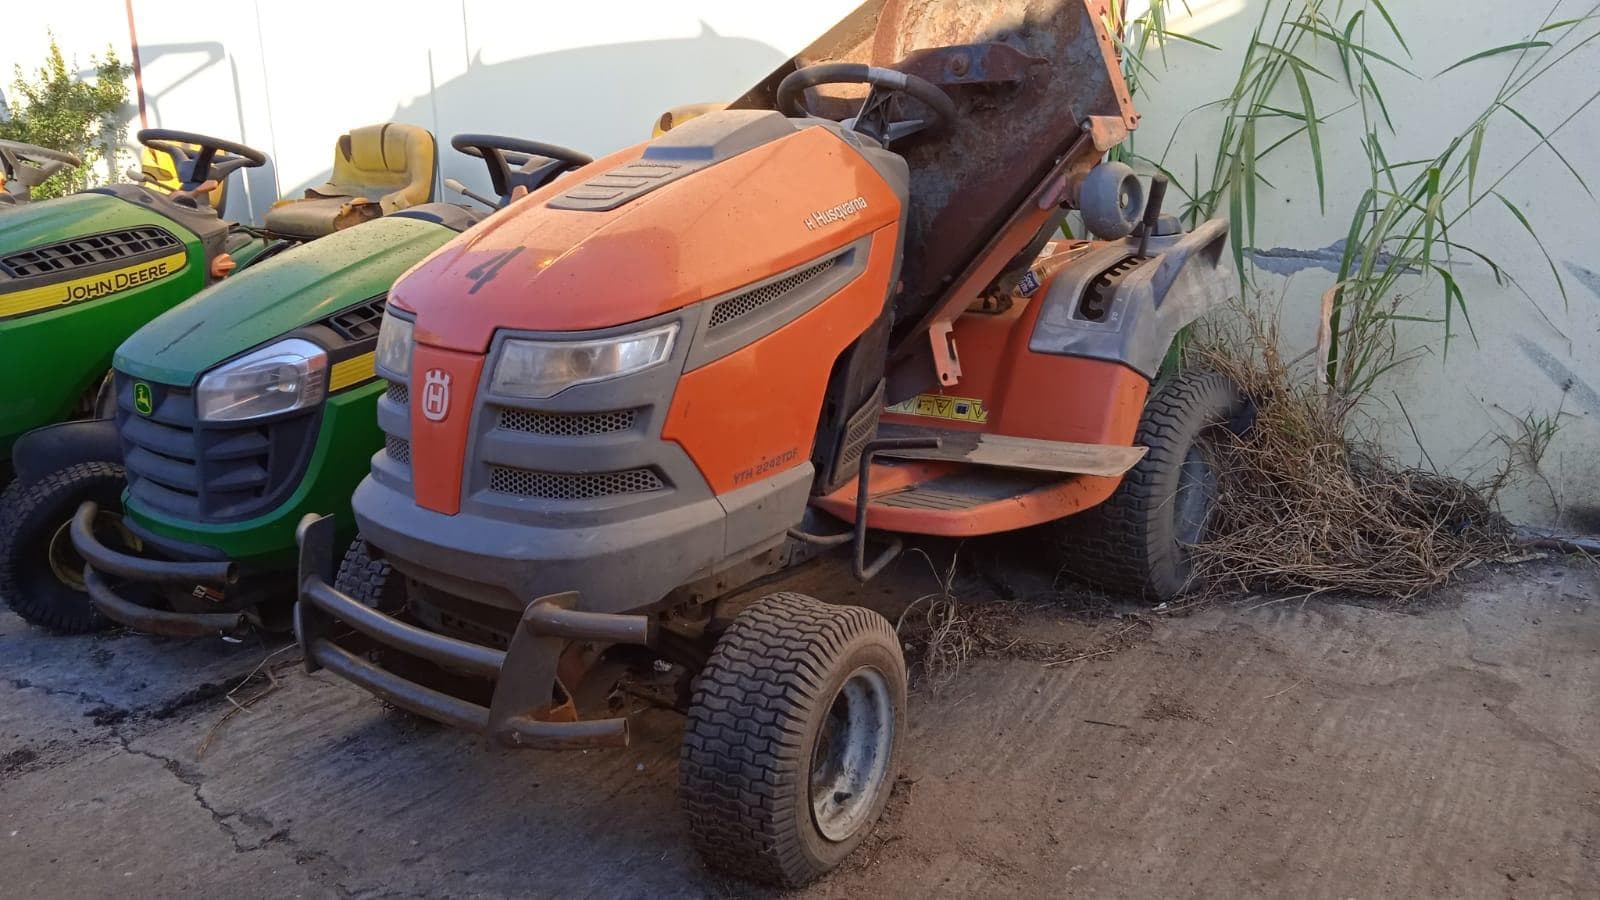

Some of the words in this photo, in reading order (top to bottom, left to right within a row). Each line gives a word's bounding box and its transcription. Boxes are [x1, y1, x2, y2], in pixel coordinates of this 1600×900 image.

[811, 196, 868, 227] Husqvarna
[62, 279, 112, 303] JOHN
[115, 263, 168, 289] DEERE
